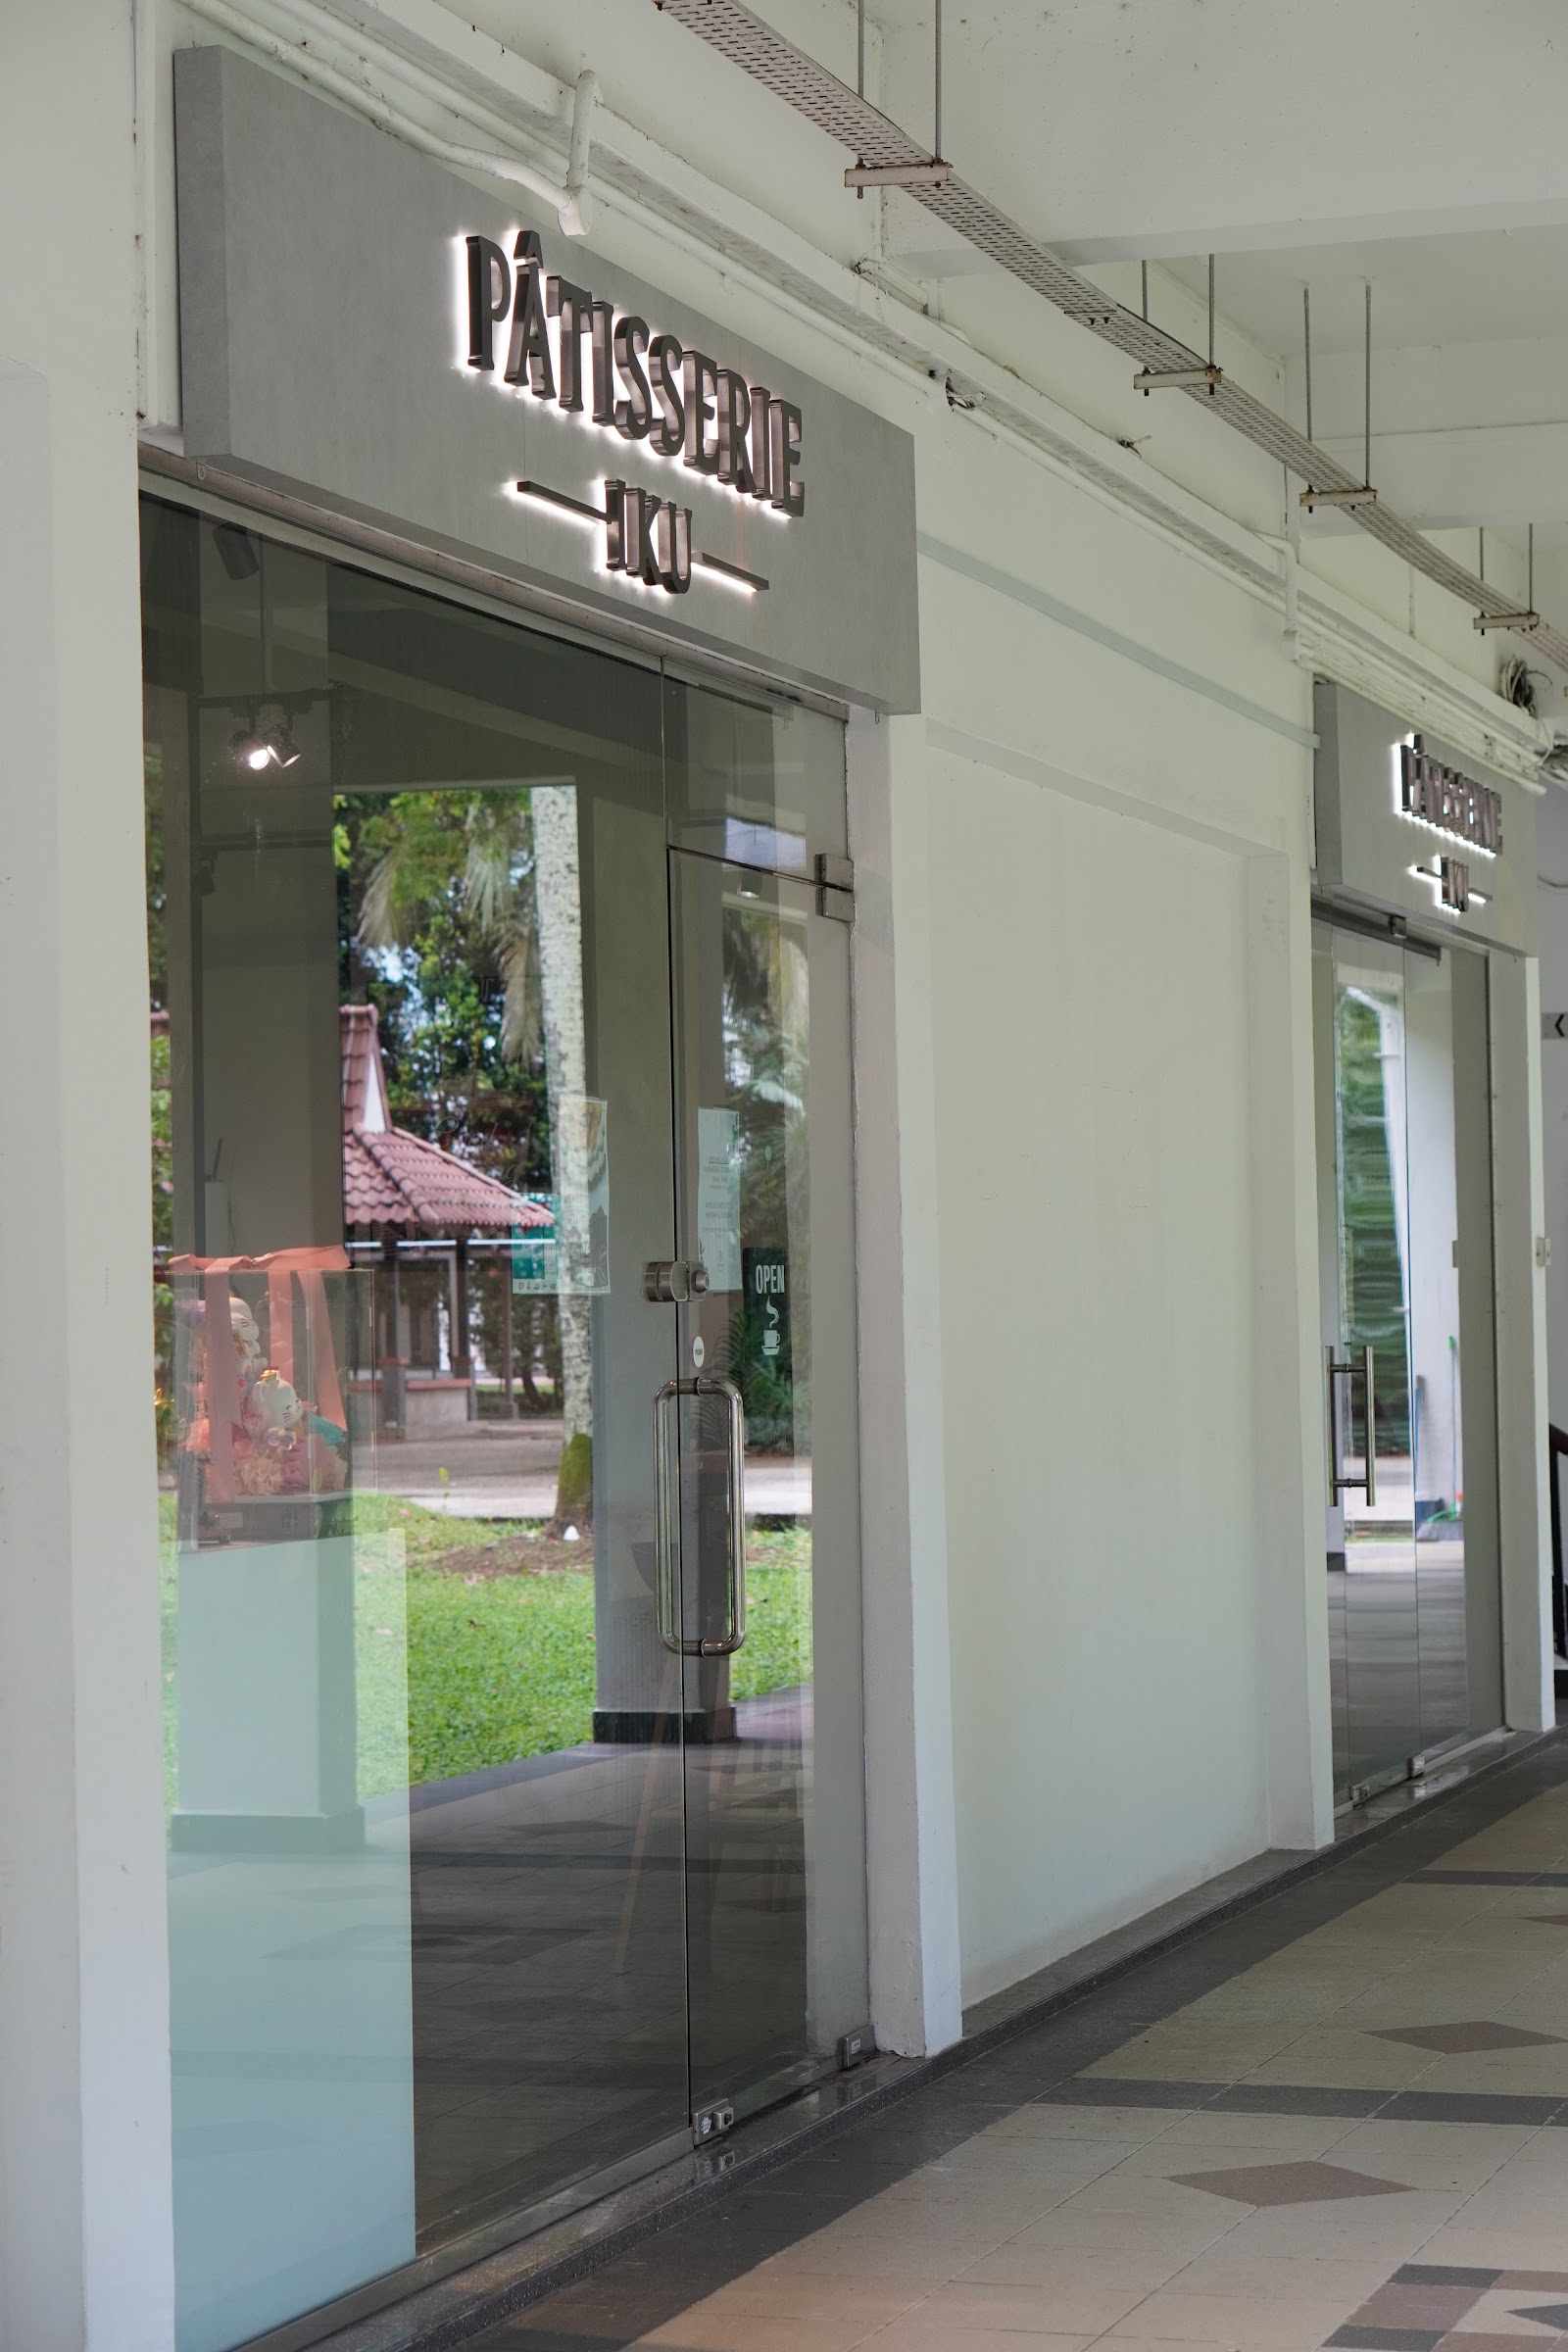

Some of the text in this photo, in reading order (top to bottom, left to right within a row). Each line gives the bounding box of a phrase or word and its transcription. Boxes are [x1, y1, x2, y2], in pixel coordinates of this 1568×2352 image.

[466, 230, 805, 517] PÂTISSERIE
[604, 478, 693, 594] IKU
[755, 1264, 785, 1295] OPEN
[694, 1348, 704, 1356] PUSH
